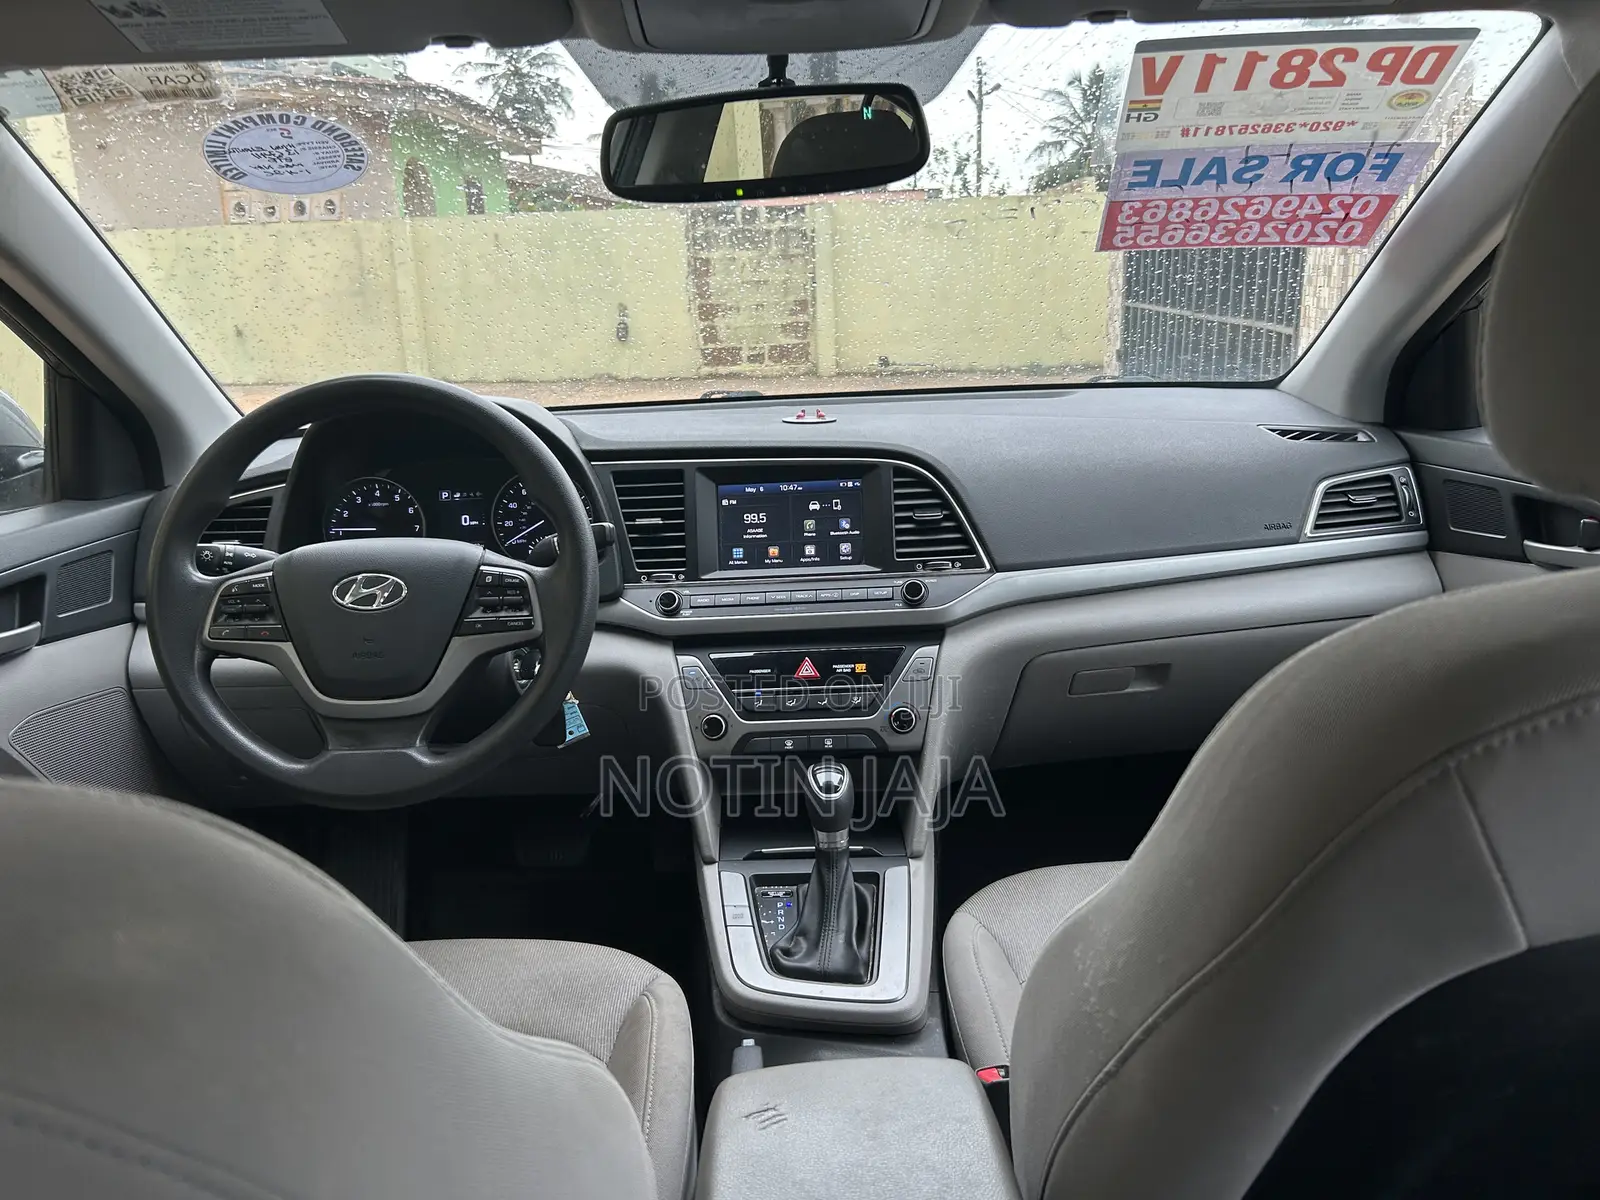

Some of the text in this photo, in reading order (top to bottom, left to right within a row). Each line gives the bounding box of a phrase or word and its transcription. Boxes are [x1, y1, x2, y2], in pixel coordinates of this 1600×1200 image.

[461, 515, 469, 526] 0
[743, 513, 767, 524] 99.5
[1263, 522, 1292, 531] AIRBAG
